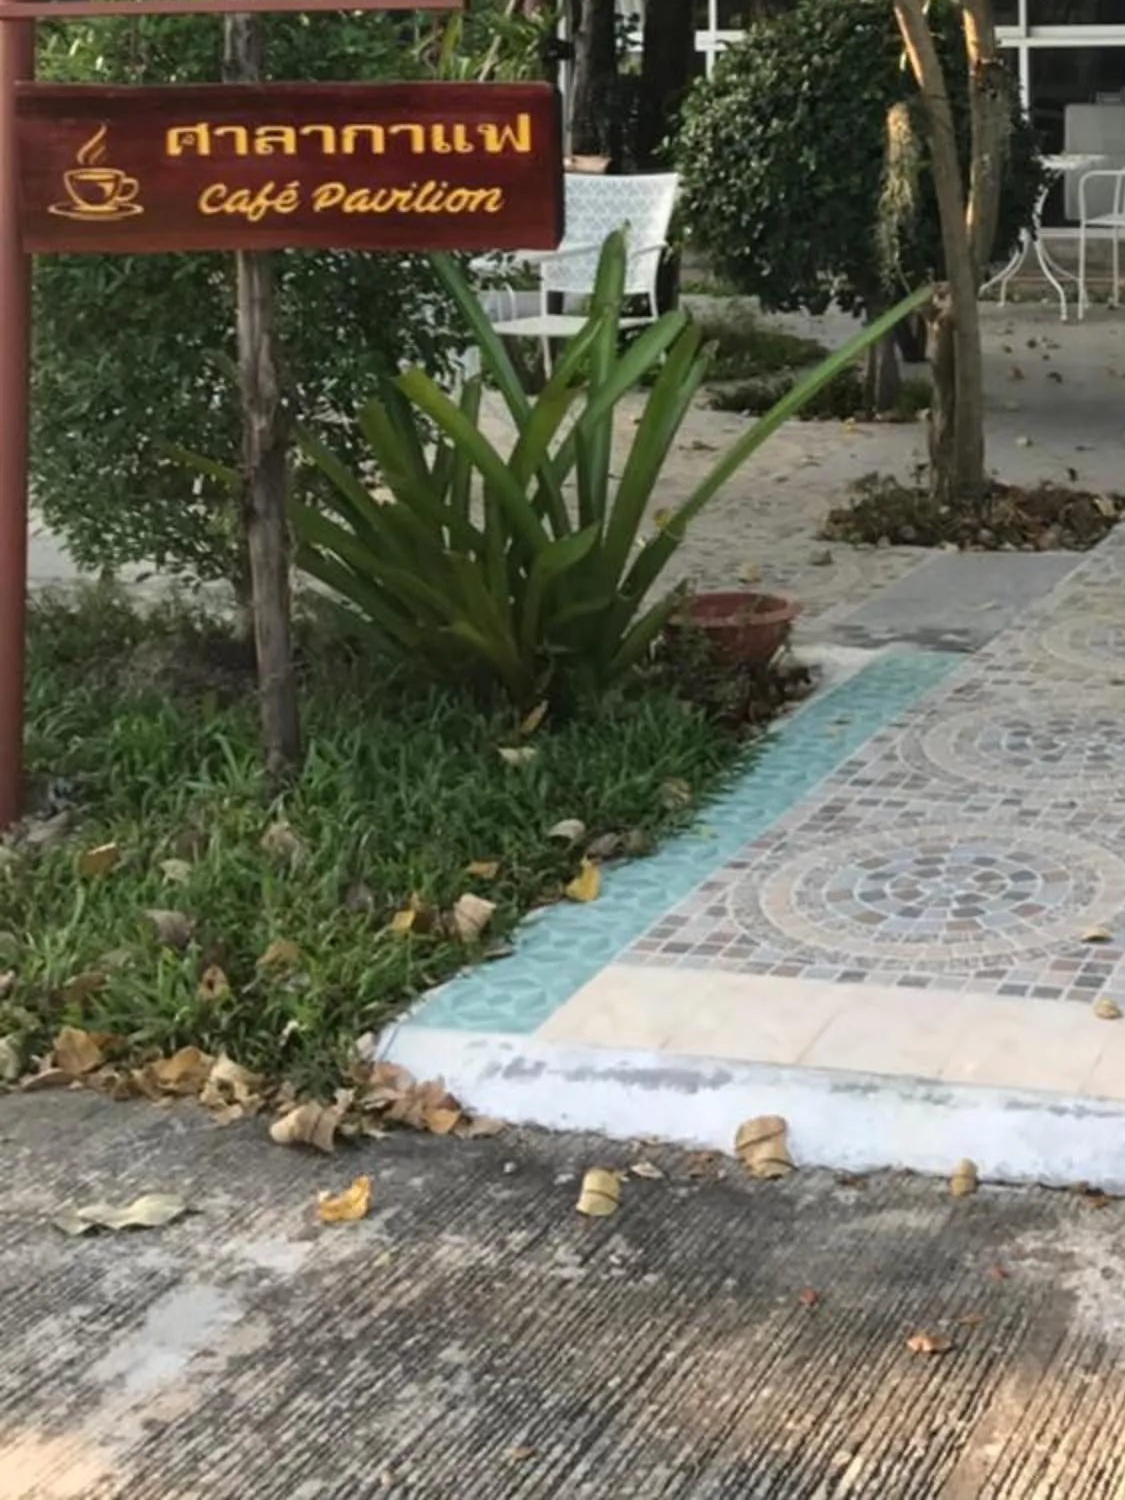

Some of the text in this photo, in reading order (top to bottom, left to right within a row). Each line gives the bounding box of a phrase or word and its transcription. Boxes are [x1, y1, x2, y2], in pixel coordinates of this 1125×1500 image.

[166, 113, 532, 156] ศาลากาแฟ
[200, 180, 503, 222] Café Pavilion
